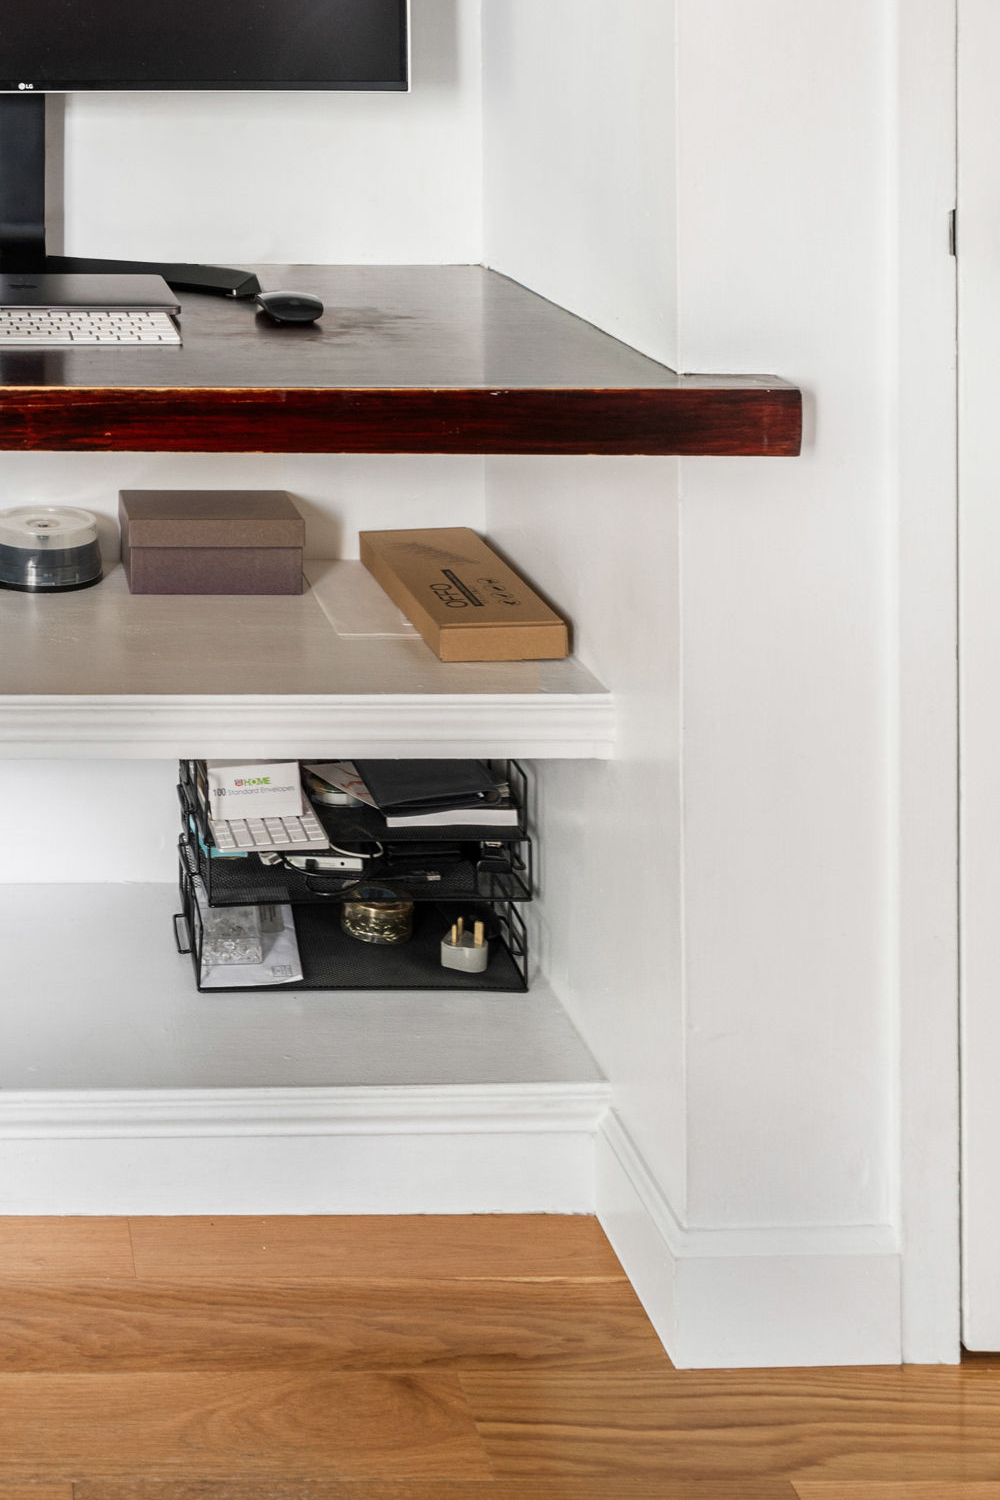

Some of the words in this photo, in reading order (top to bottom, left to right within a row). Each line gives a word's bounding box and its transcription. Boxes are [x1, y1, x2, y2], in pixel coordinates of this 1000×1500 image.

[429, 583, 468, 608] OFFO
[244, 777, 270, 786] HOME
[213, 788, 226, 796] 100
[228, 787, 260, 796] Standard
[260, 786, 295, 794] Envelopes
